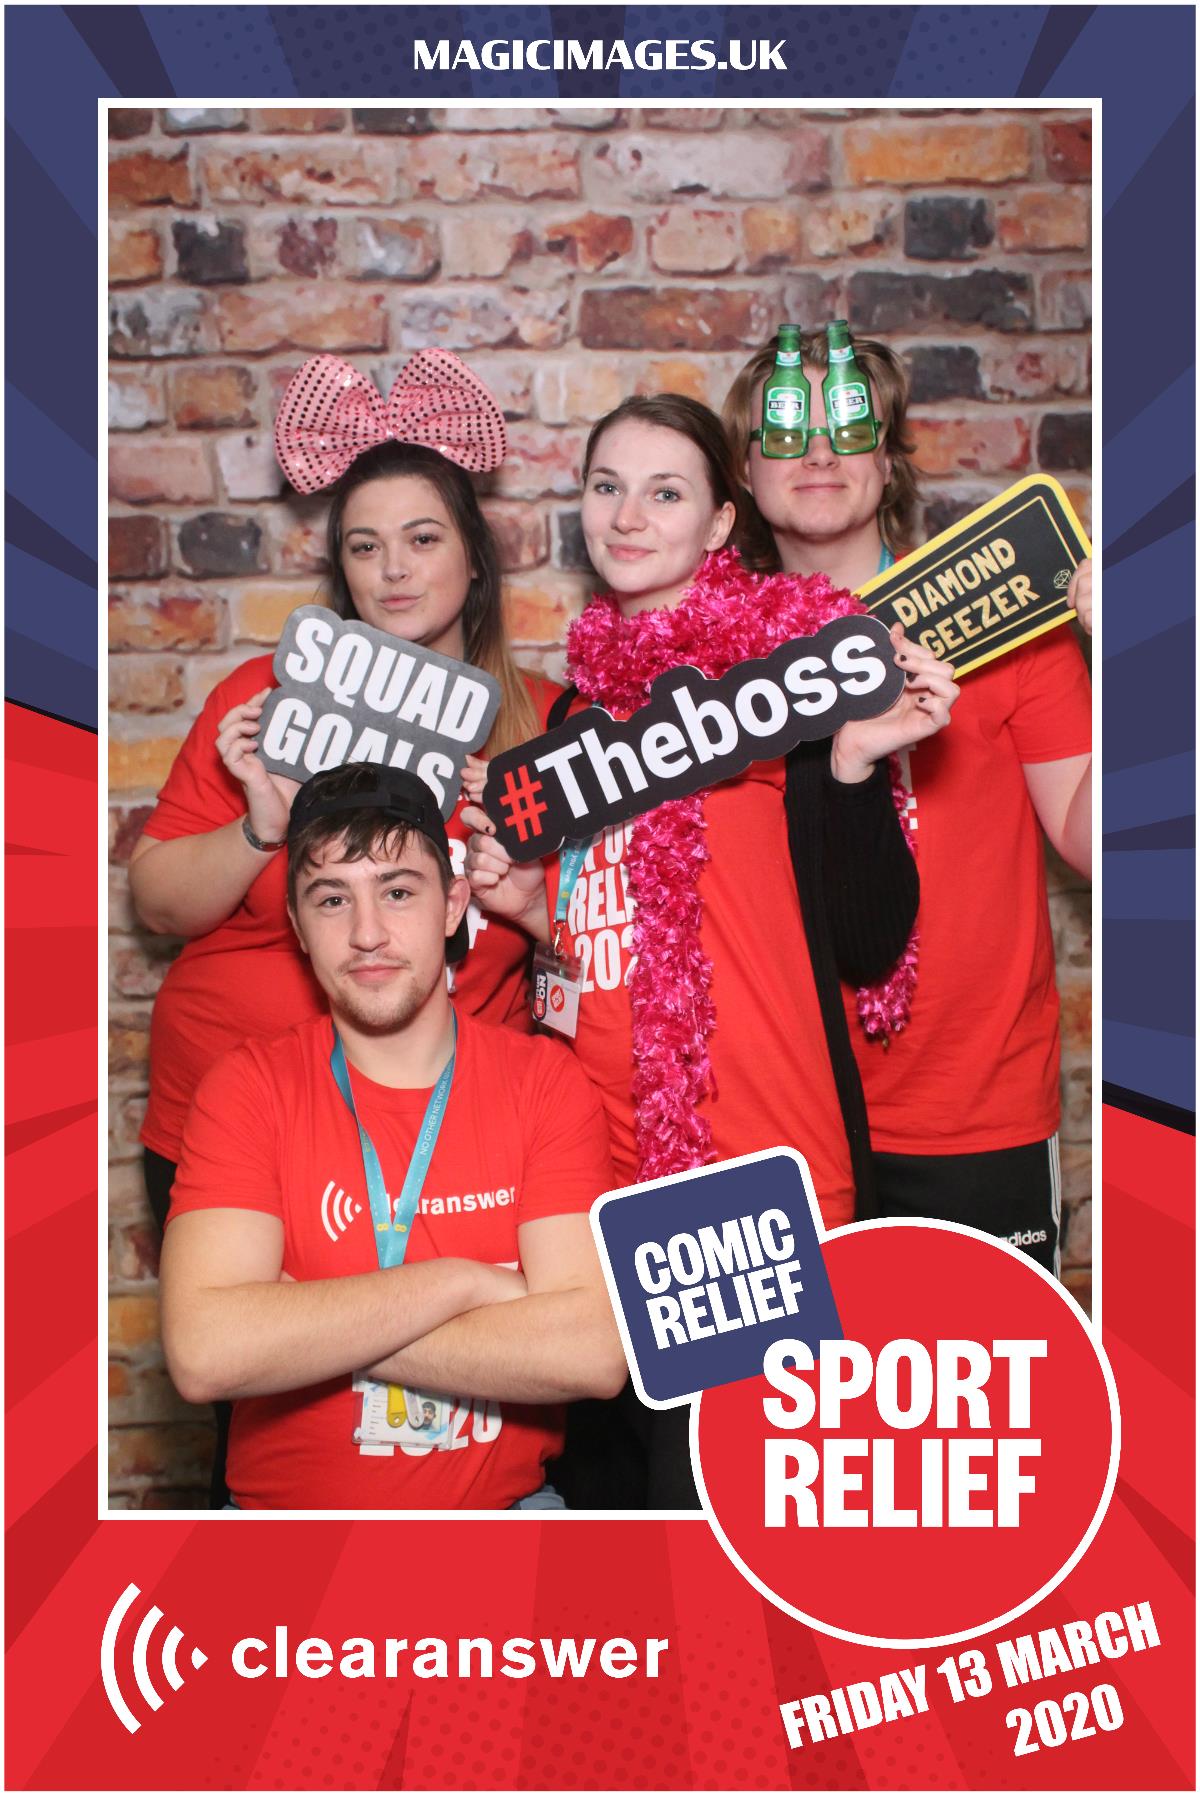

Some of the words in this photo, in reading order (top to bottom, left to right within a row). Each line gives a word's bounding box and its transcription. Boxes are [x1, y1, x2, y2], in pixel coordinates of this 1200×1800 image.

[891, 537, 1016, 628] DIAMOND
[919, 574, 1040, 660] GEEZER
[284, 617, 490, 743] SQUAD
[500, 634, 887, 842] #Theboss
